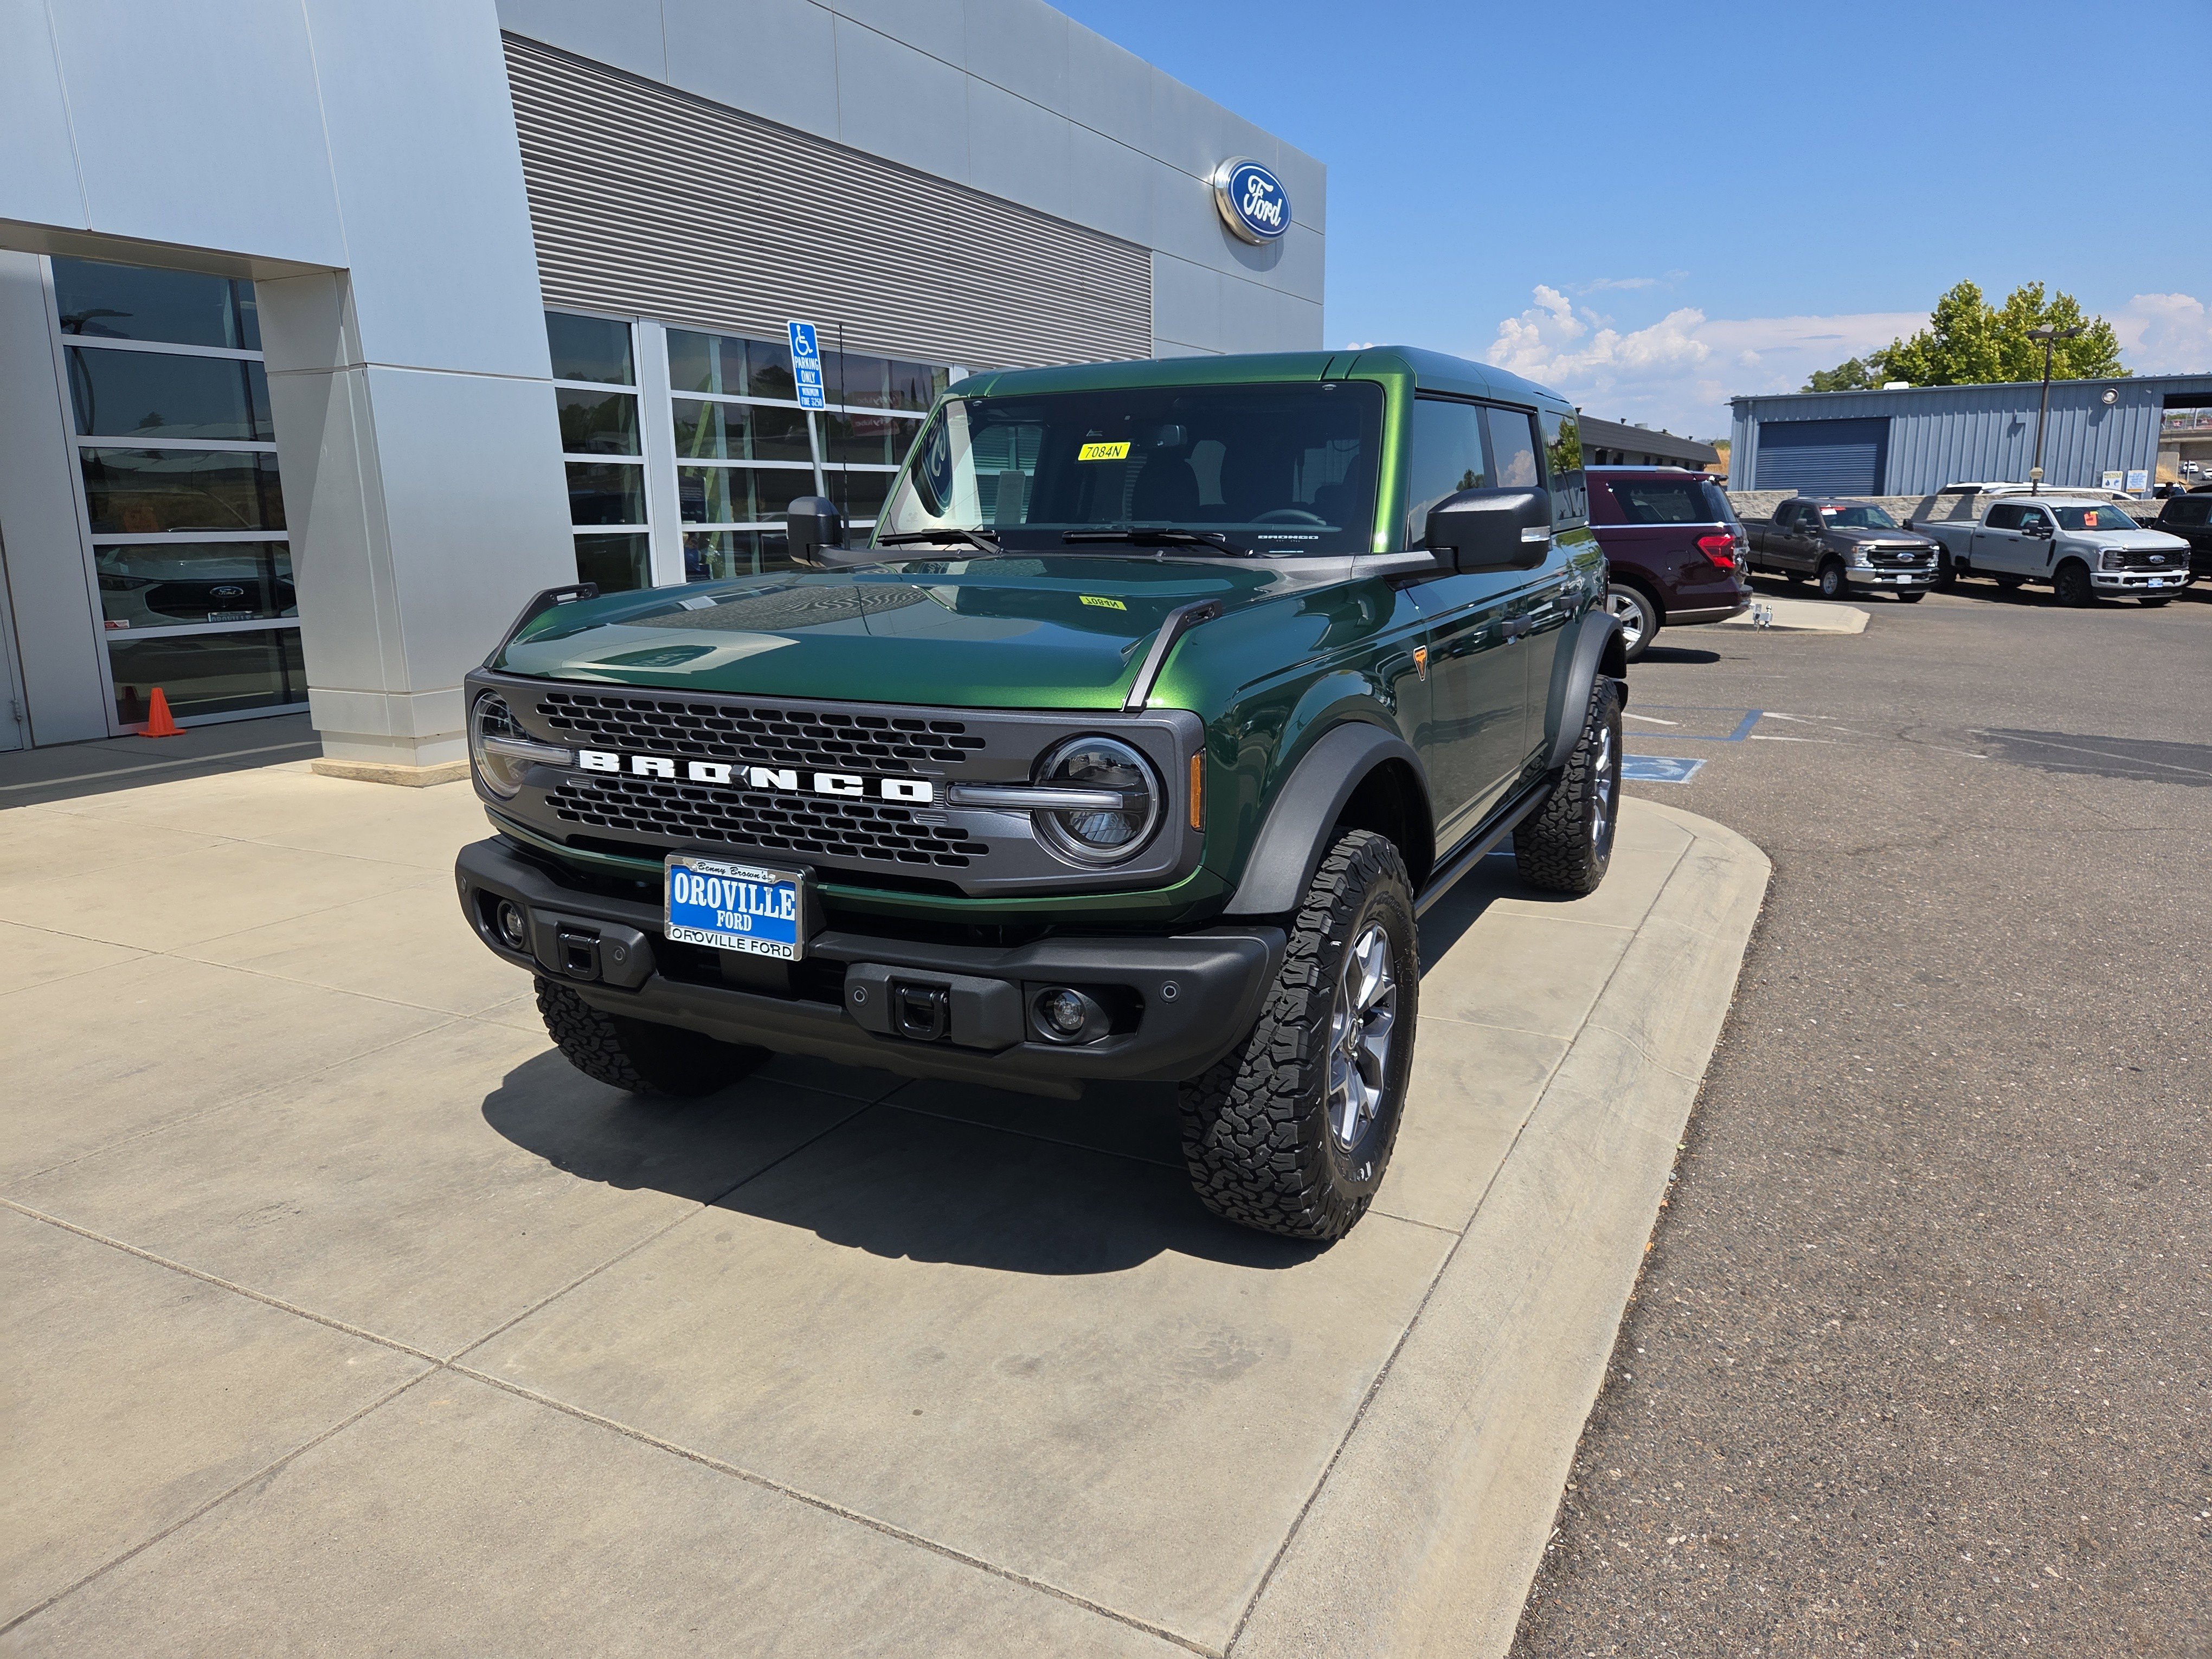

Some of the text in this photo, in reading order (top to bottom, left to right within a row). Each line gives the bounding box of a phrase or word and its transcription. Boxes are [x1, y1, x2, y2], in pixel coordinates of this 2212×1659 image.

[1244, 175, 1282, 227] Ford
[794, 356, 819, 370] PARKING
[801, 370, 815, 383] ONLY
[1085, 445, 1122, 458] 7084N
[579, 750, 933, 802] BRONCO
[697, 862, 768, 879] Benny Brown's
[674, 873, 795, 921] OROVILLE
[716, 910, 752, 931] FORD
[672, 928, 792, 957] OROVILLE FORD
